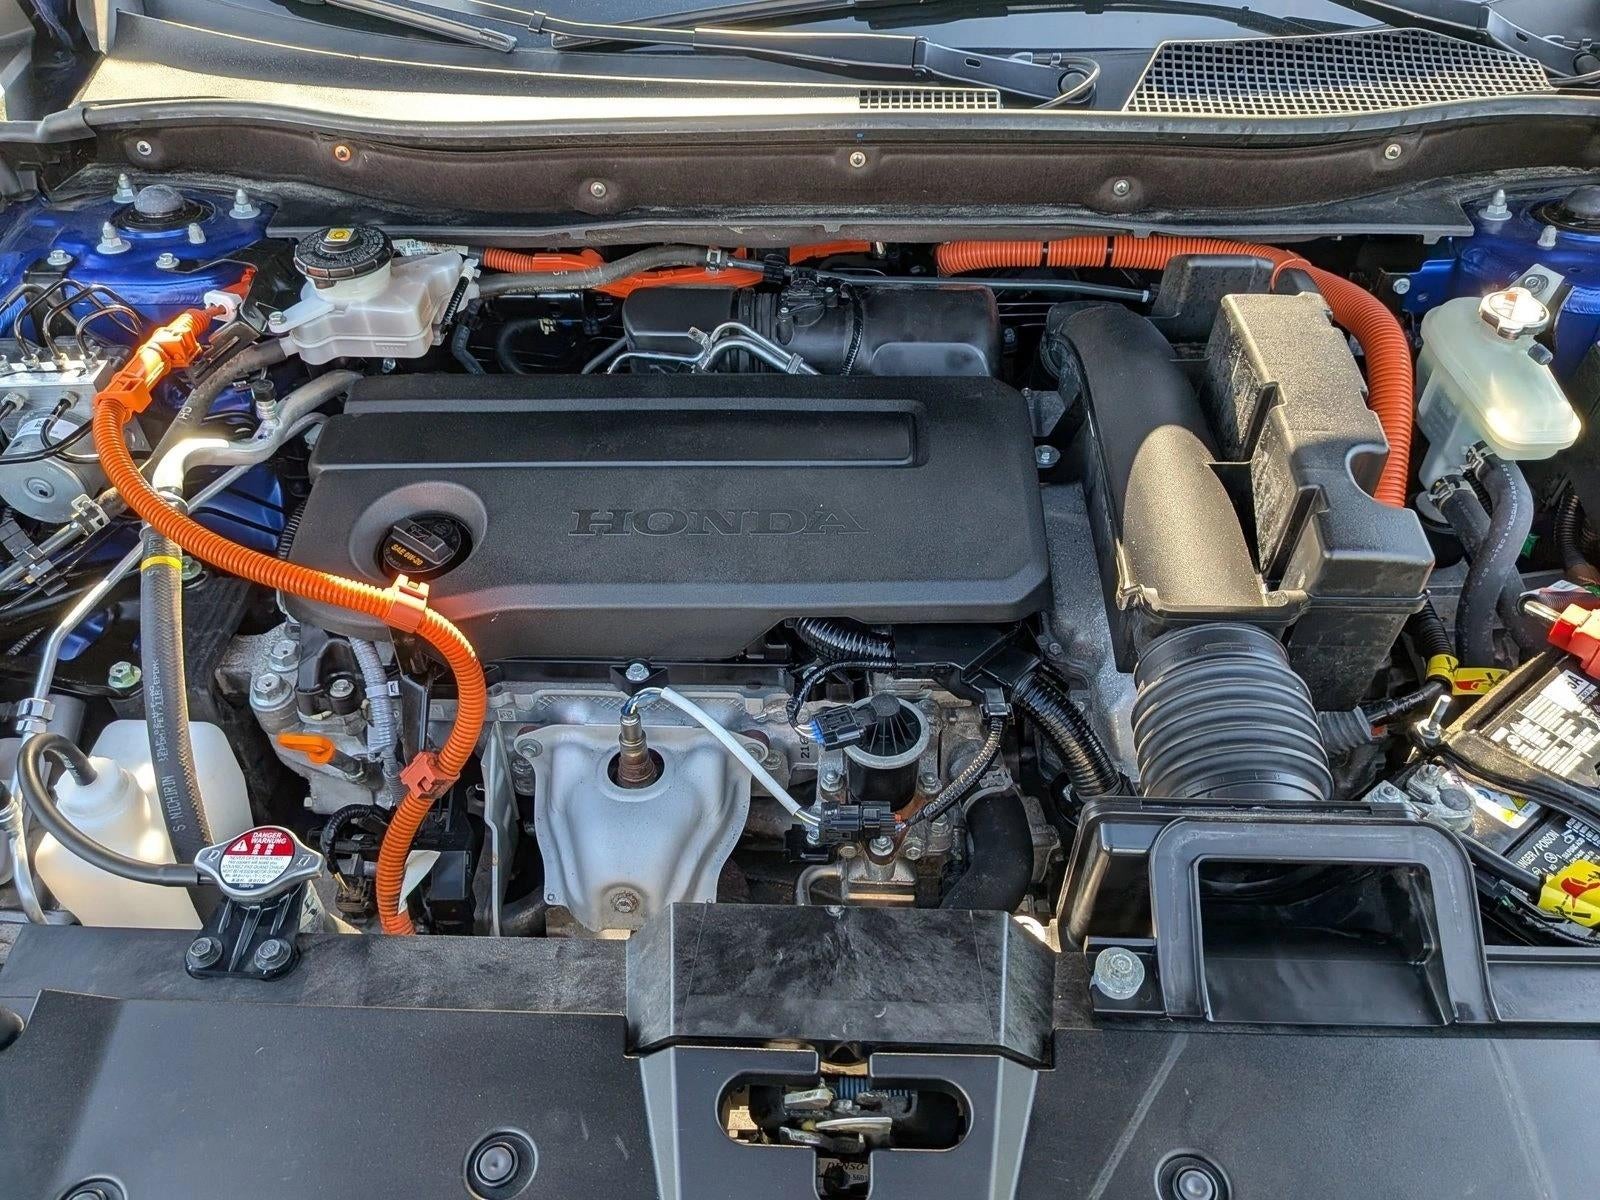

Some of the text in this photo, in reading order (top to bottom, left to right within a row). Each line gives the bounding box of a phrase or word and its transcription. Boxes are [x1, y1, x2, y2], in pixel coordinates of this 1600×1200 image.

[568, 508, 870, 537] HONDA
[390, 543, 424, 566] SAE 0W-20
[161, 775, 185, 820] NICHIRIN
[250, 837, 288, 845] WARNUNG
